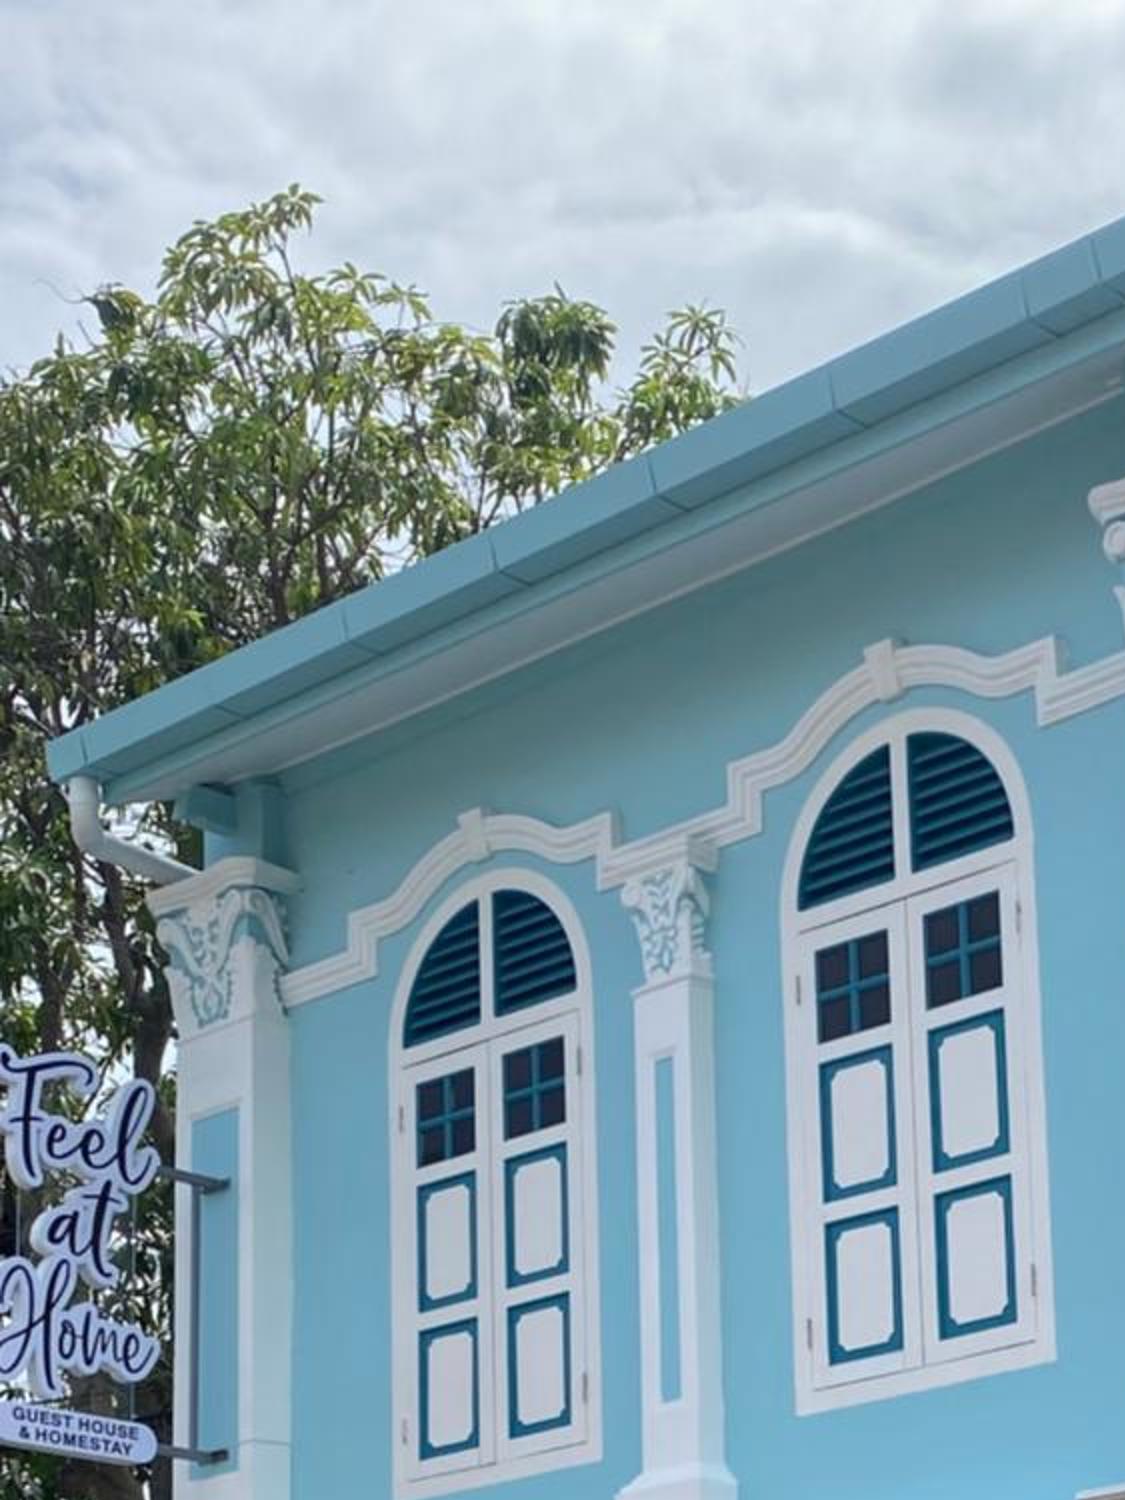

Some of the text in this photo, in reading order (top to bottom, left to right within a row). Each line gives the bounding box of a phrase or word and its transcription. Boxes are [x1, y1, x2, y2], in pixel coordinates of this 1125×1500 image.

[1, 1052, 152, 1185] Feel
[48, 1180, 122, 1277] at
[0, 1258, 153, 1390] Home
[13, 1406, 139, 1440] GUEST HOUSE
[19, 1426, 133, 1456] & HOMESTAY
